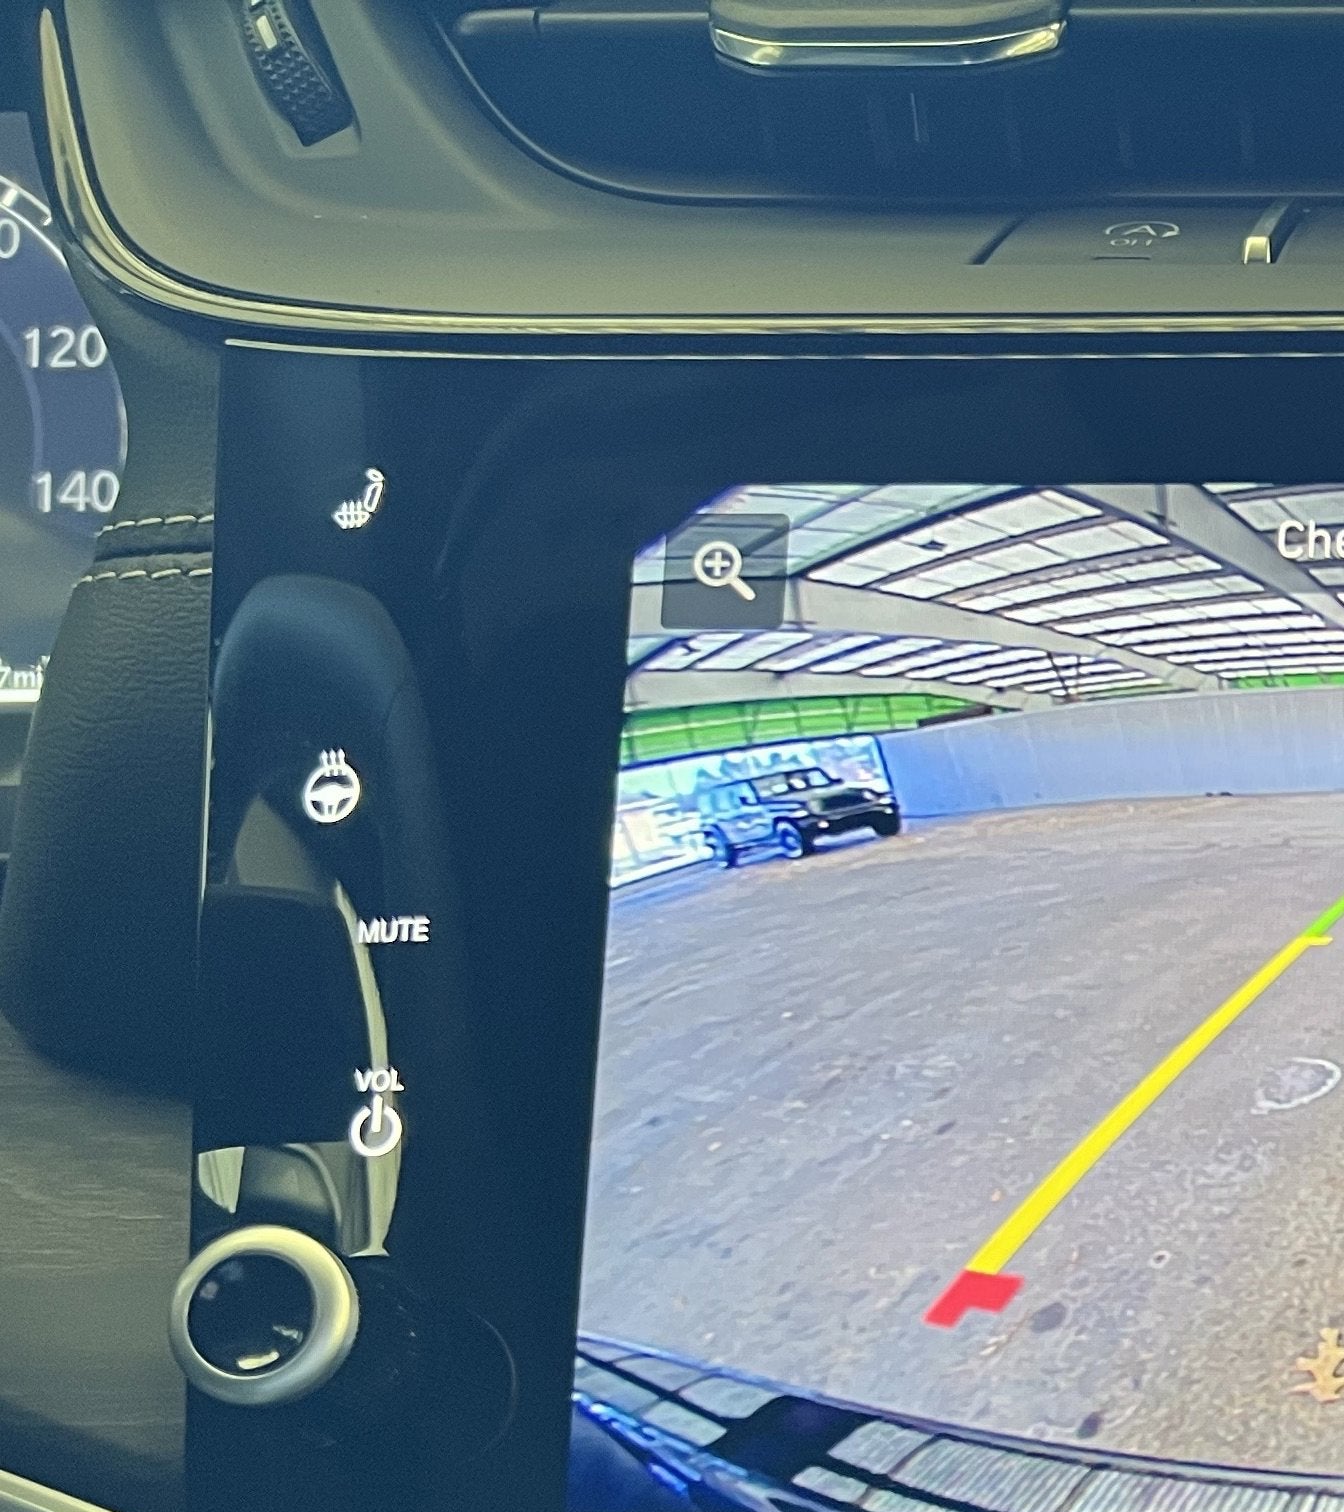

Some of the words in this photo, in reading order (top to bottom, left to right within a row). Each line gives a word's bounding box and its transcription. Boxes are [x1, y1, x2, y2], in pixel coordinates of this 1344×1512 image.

[24, 325, 107, 369] 120
[34, 469, 120, 513] 140
[358, 916, 430, 944] MUTE
[354, 1067, 404, 1092] VOL
